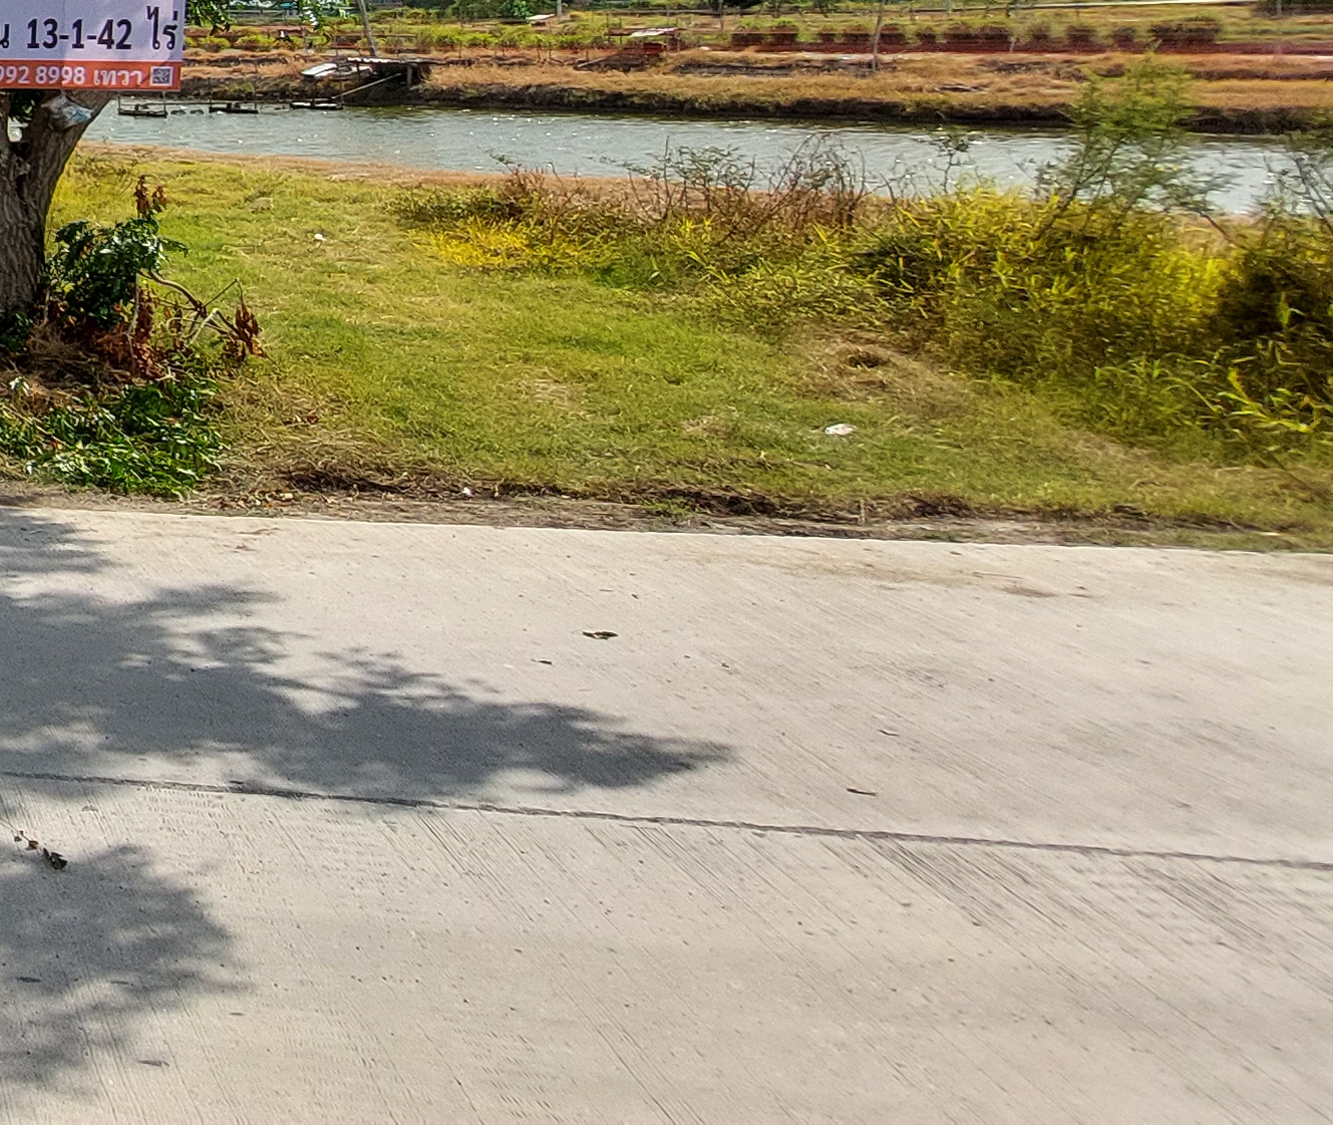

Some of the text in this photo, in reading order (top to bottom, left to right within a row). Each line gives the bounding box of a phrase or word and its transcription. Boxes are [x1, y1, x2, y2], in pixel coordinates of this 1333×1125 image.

[26, 18, 132, 50] 13-1-42
[146, 5, 179, 51] ไร่
[35, 65, 86, 85] 8998
[93, 69, 143, 86] เทวา
